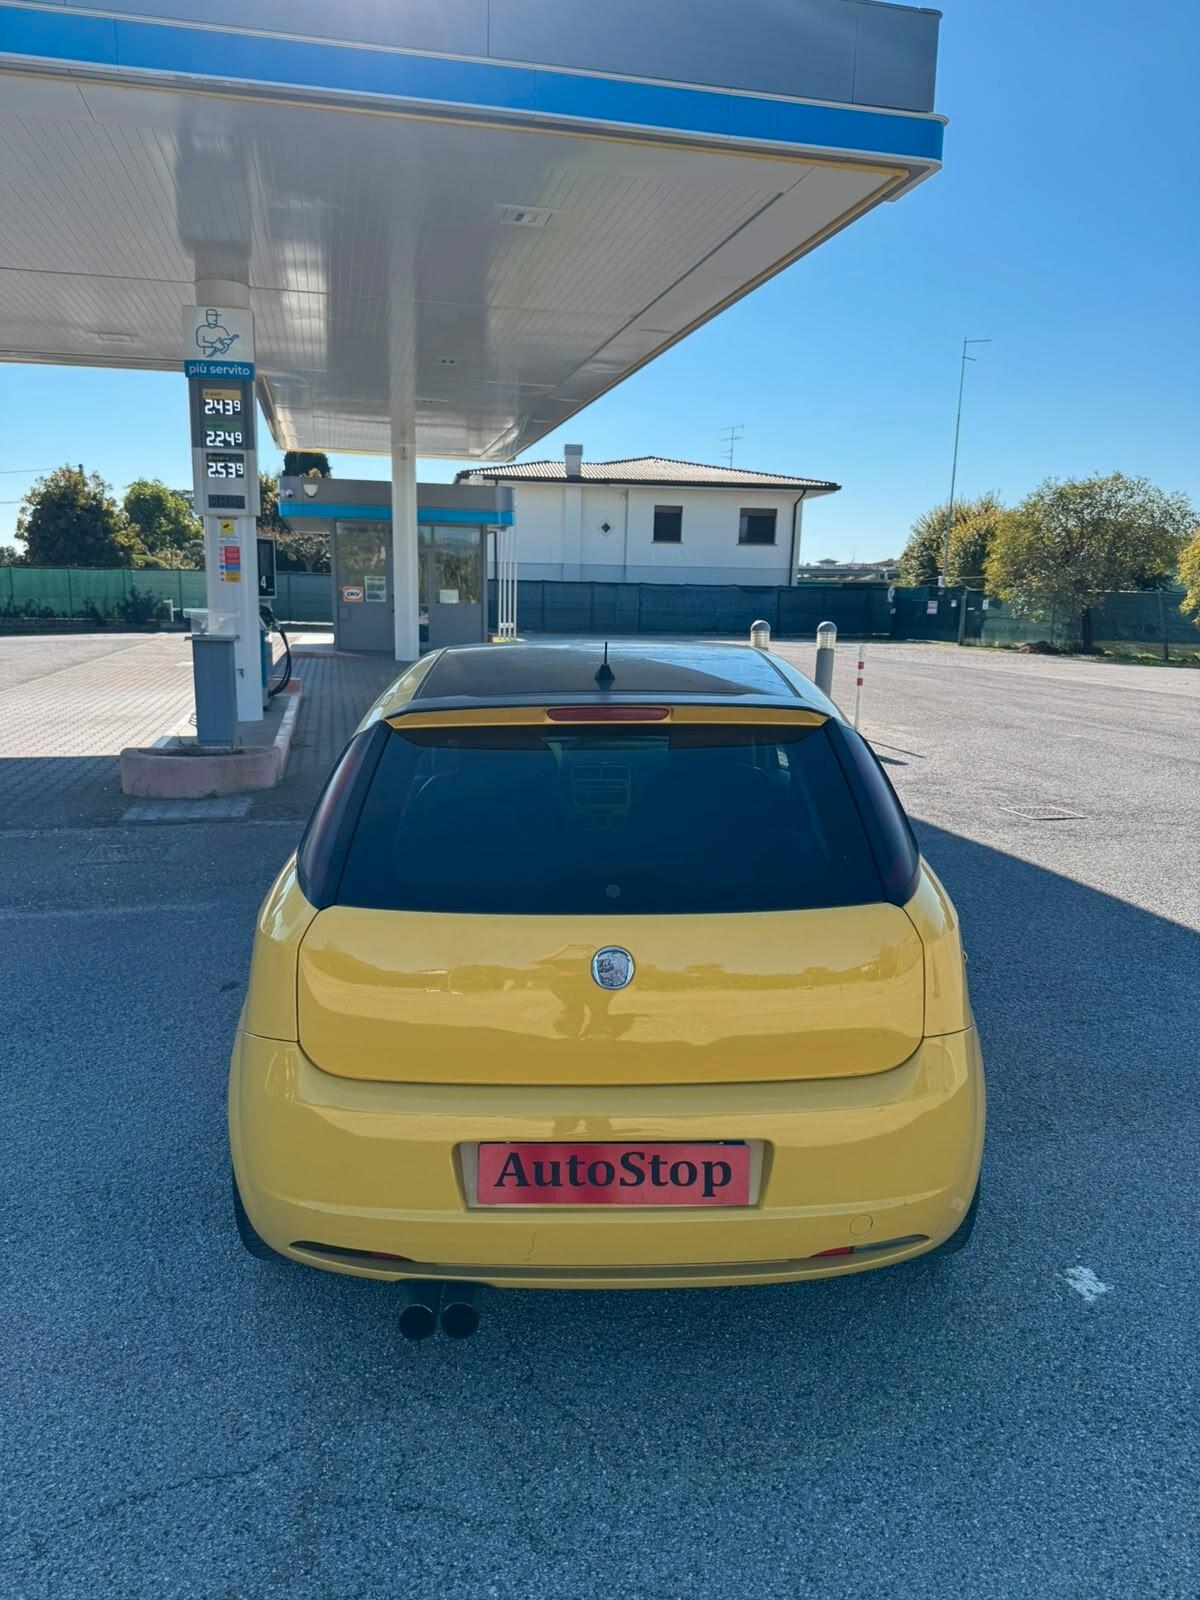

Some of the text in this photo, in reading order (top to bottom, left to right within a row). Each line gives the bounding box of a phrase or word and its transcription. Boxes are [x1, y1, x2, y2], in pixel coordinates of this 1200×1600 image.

[210, 364, 250, 376] servito
[260, 575, 267, 589] 4
[493, 1151, 732, 1197] AutoStop
